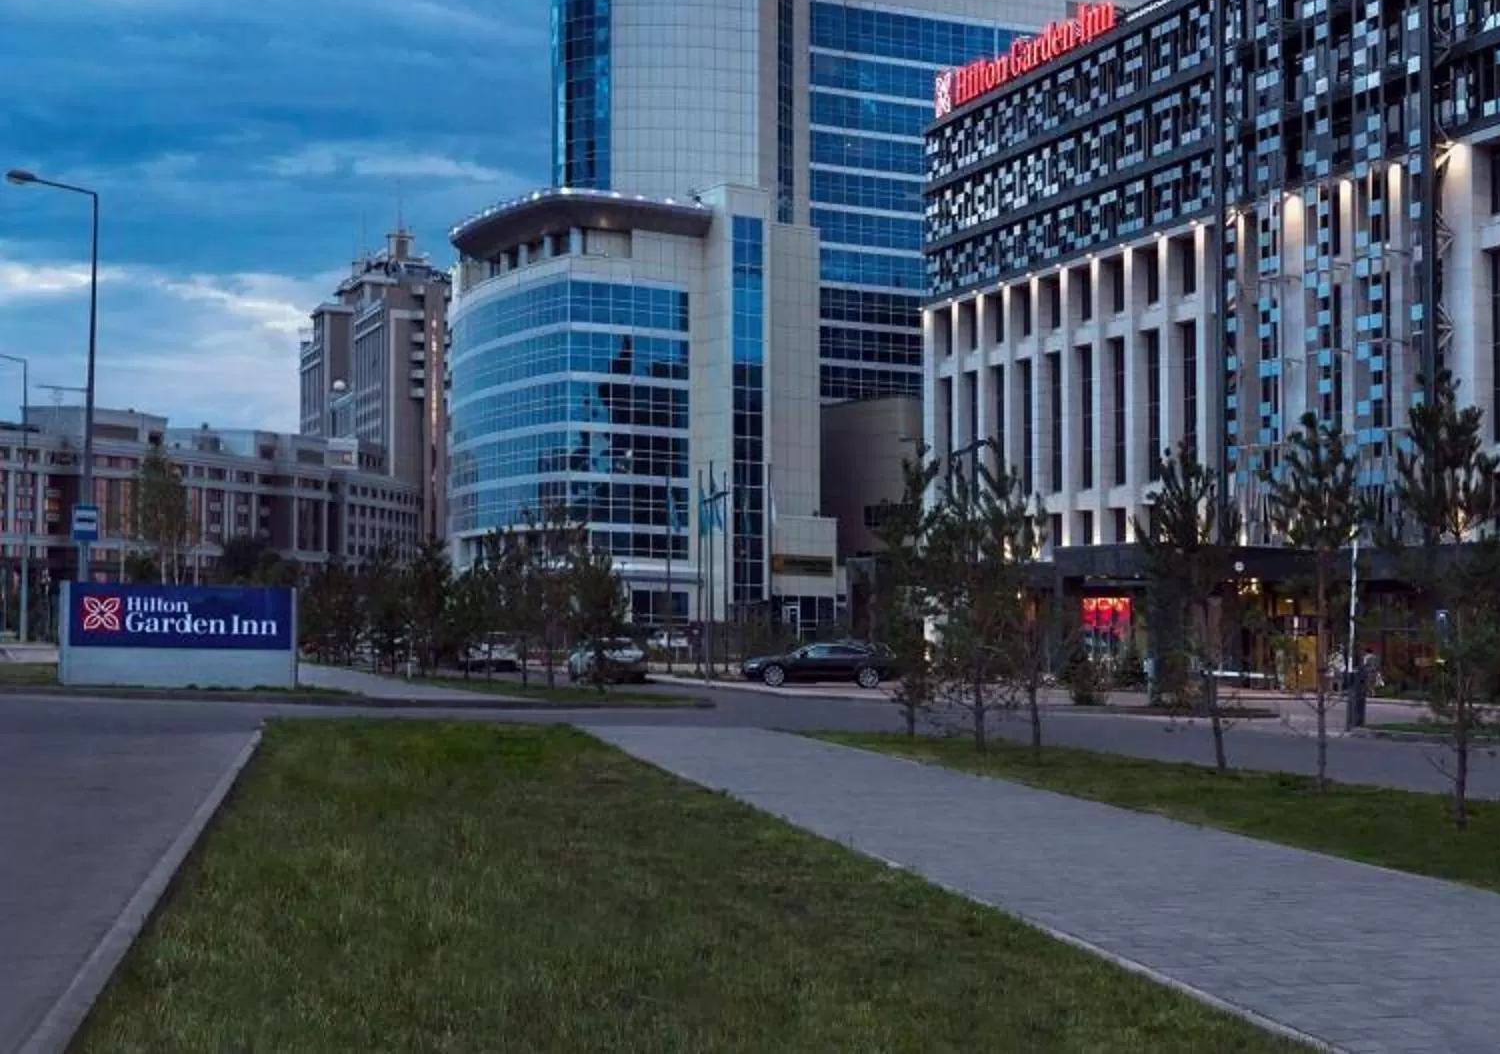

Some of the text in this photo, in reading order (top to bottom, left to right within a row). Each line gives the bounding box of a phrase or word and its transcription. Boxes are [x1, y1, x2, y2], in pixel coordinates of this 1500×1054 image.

[955, 2, 1115, 106] Hilton Garden Inn
[127, 597, 189, 613] Hilton
[125, 612, 277, 635] Garden Inn
